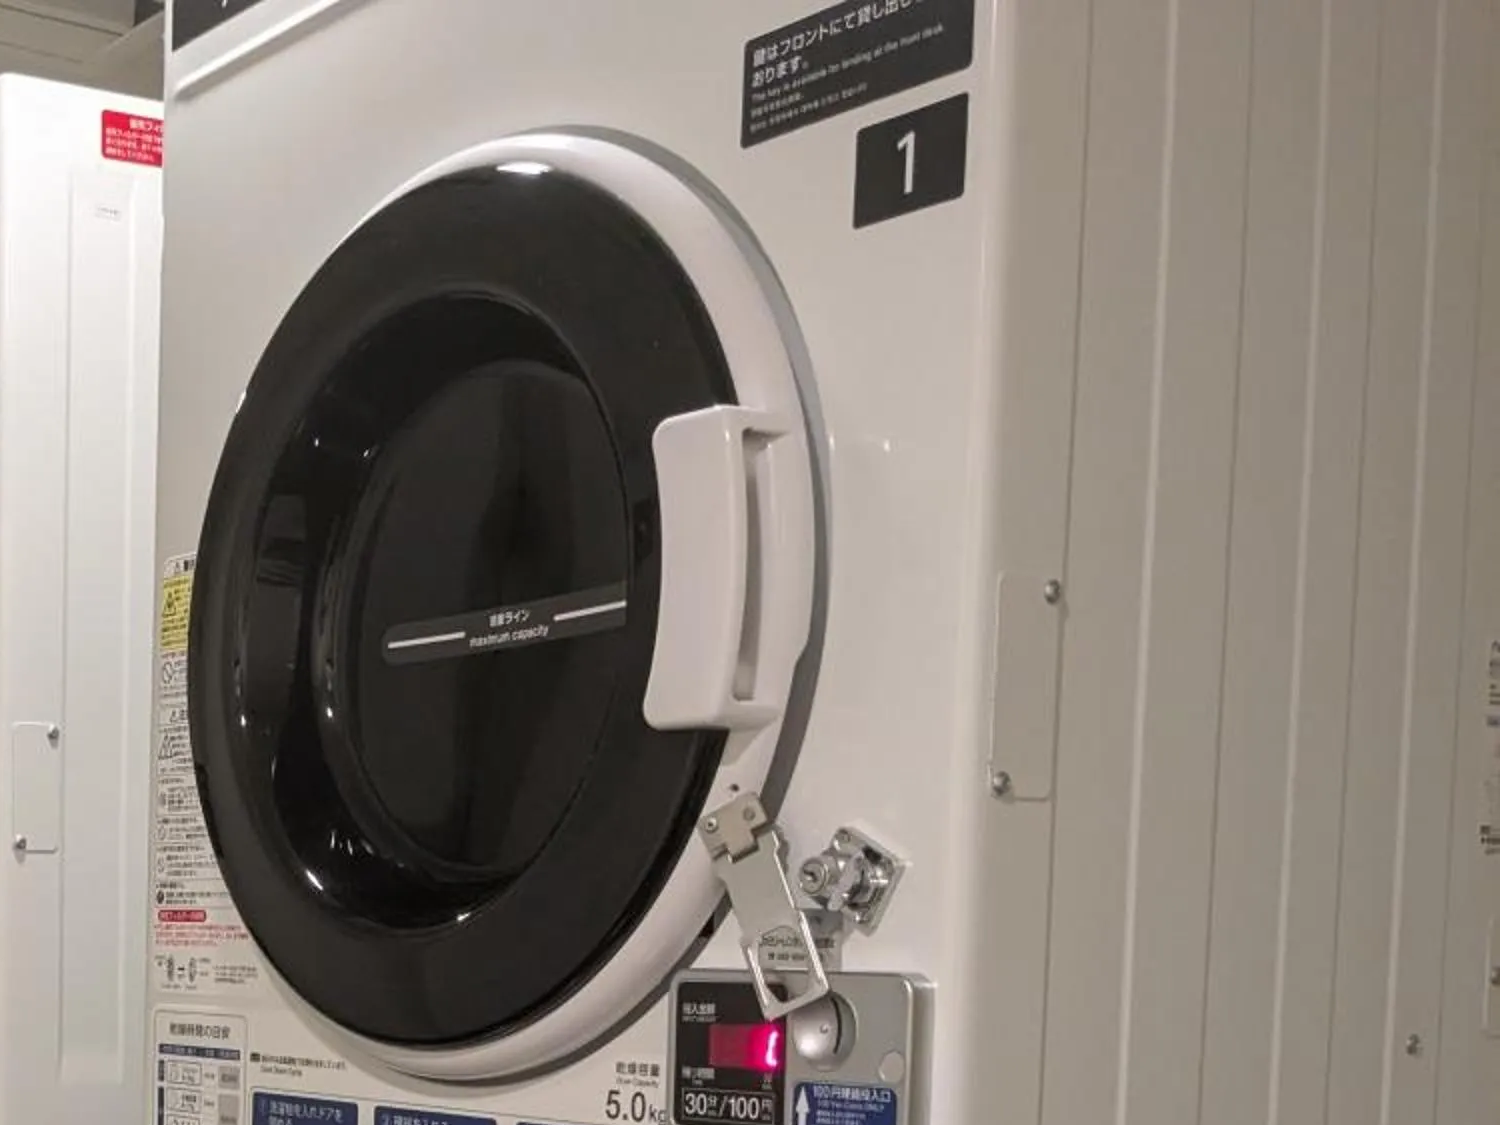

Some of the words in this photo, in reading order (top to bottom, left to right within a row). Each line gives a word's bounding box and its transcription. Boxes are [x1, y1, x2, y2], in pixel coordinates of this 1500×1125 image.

[753, 0, 922, 67] 鍵はフロントにて貸し出し
[897, 129, 916, 195] 1
